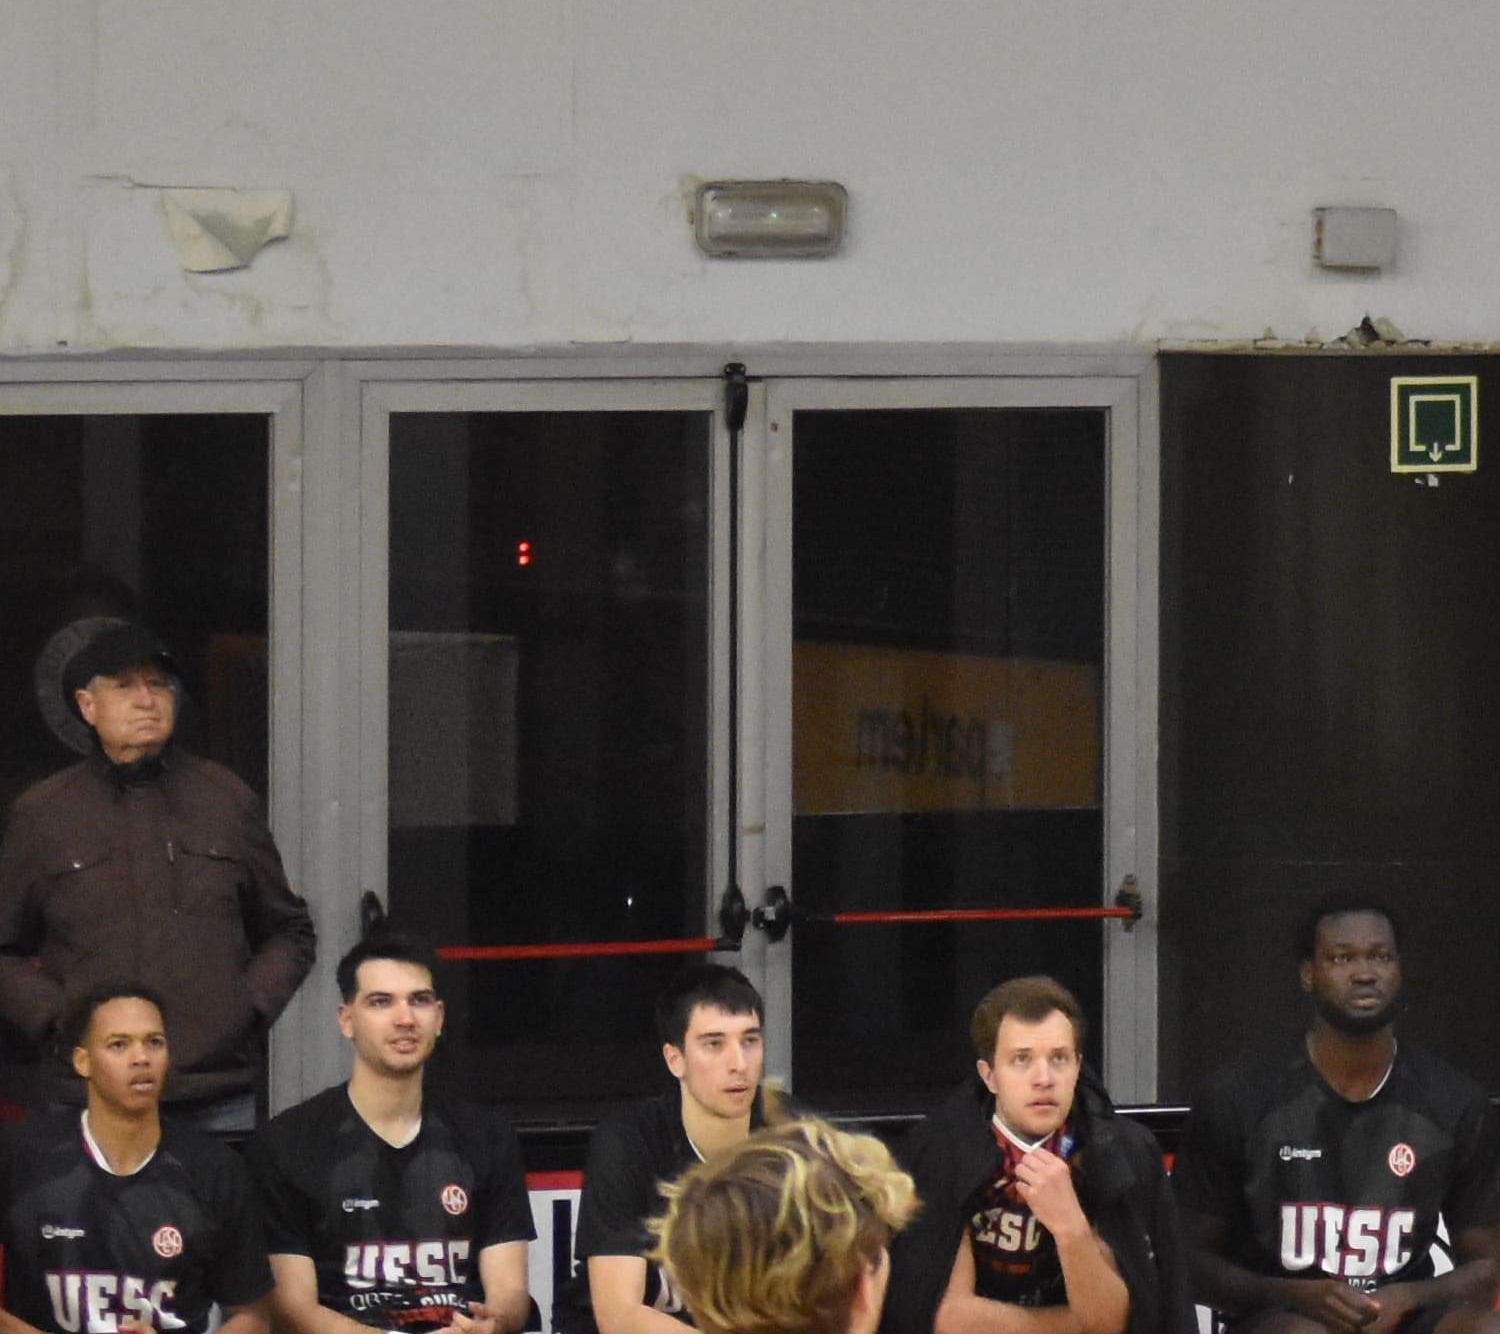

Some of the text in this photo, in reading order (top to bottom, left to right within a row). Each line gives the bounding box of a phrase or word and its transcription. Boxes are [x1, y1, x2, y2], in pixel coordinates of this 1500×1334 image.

[344, 1239, 470, 1289] UESC
[1280, 1205, 1415, 1277] UESC
[45, 1273, 187, 1333] UESC
